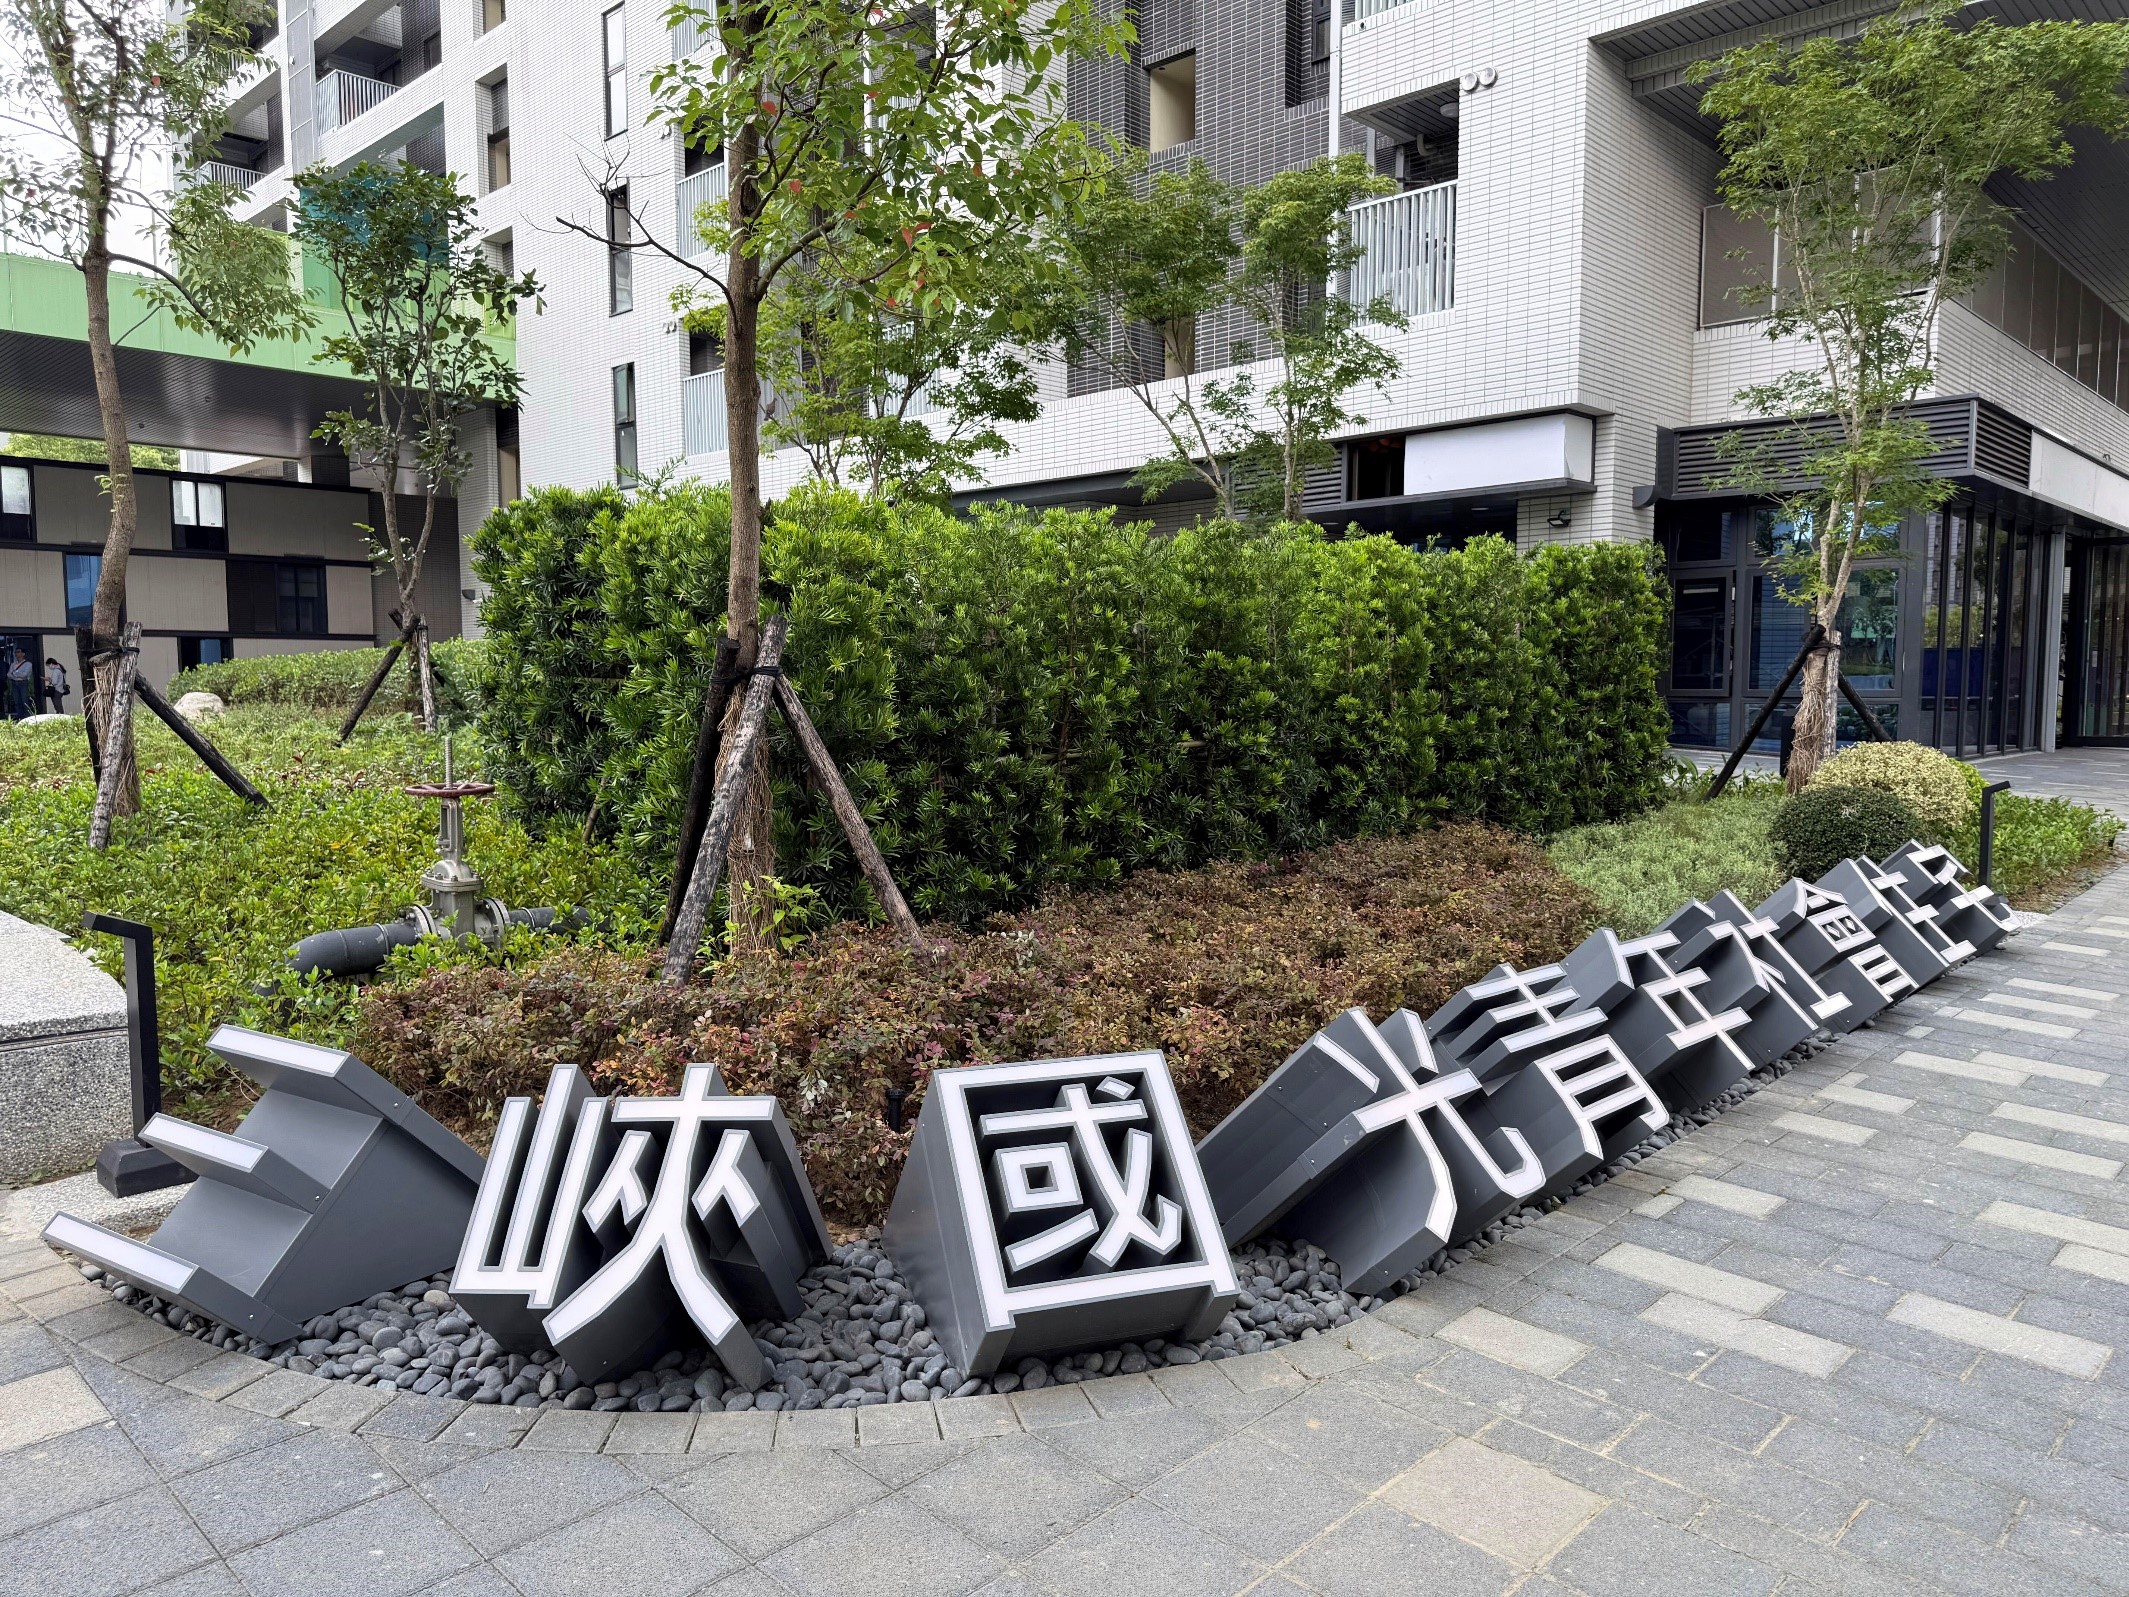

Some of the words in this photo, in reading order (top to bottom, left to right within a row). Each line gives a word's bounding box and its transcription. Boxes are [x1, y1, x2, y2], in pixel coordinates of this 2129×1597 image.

[41, 838, 2022, 1346] 三峽國光青年社會住宅
